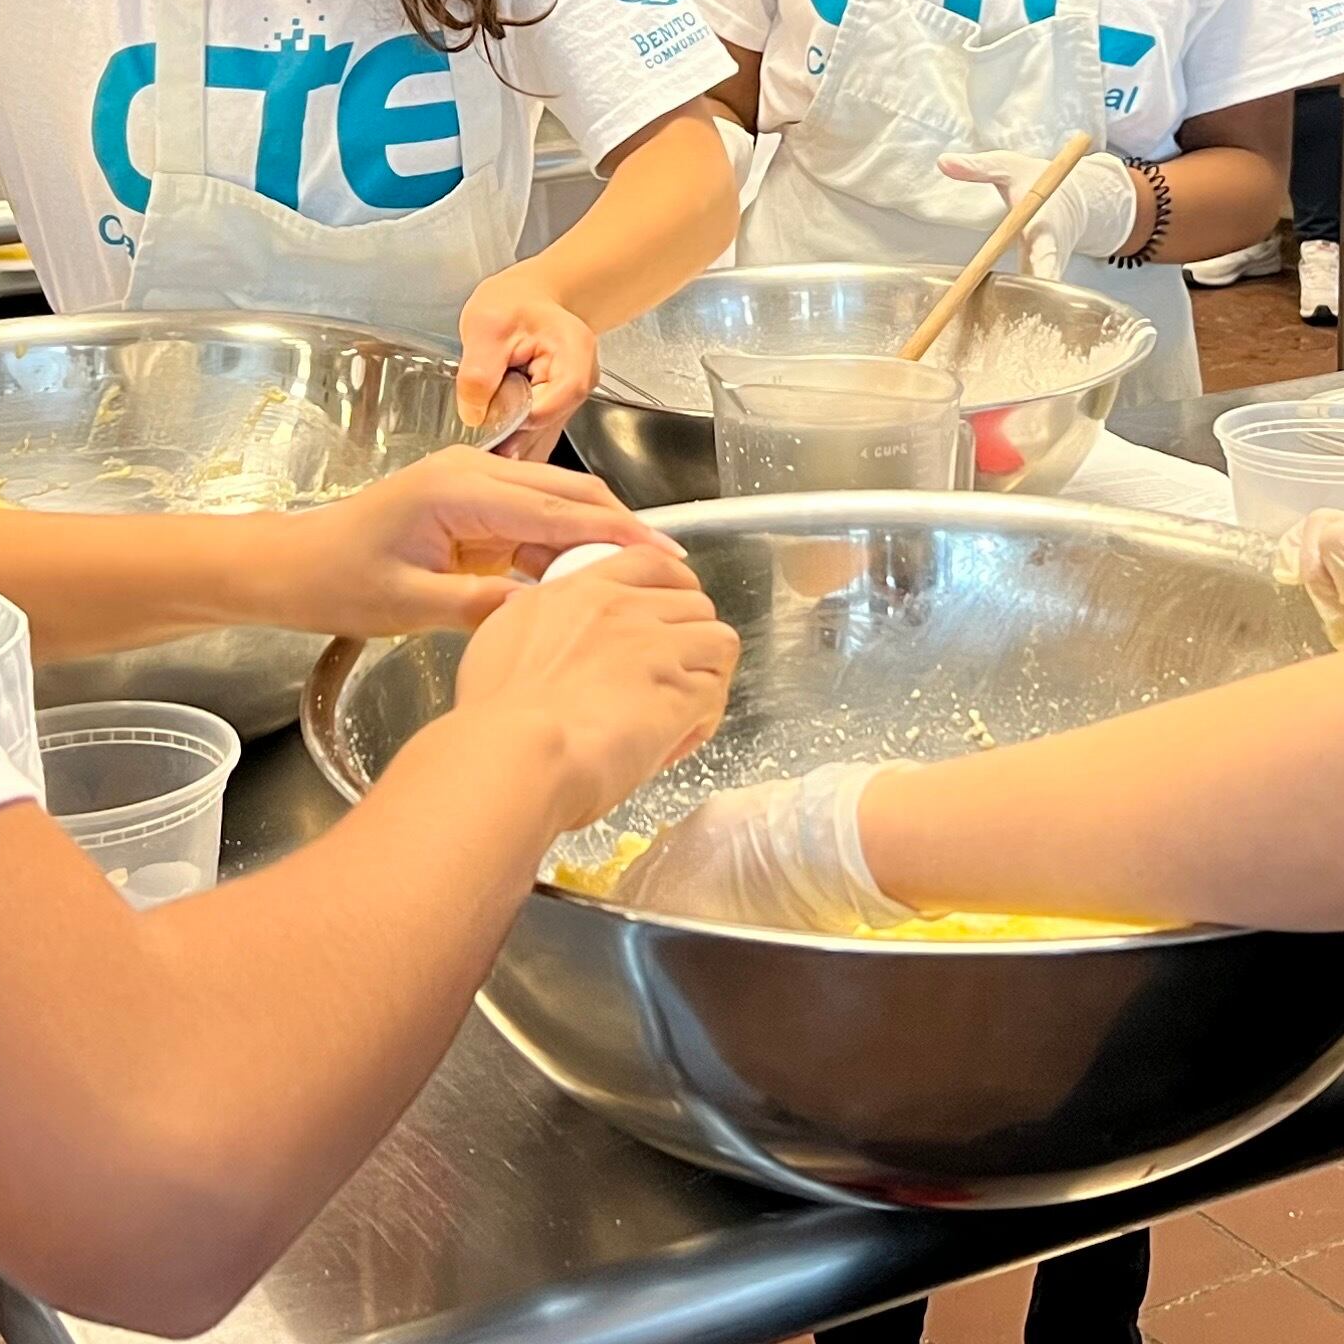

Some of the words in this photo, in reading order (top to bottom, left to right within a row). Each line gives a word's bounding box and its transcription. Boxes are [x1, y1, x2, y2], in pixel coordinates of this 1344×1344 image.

[630, 11, 696, 56] BENITO
[644, 25, 710, 69] COMMUNITY
[91, 31, 465, 216] CTE
